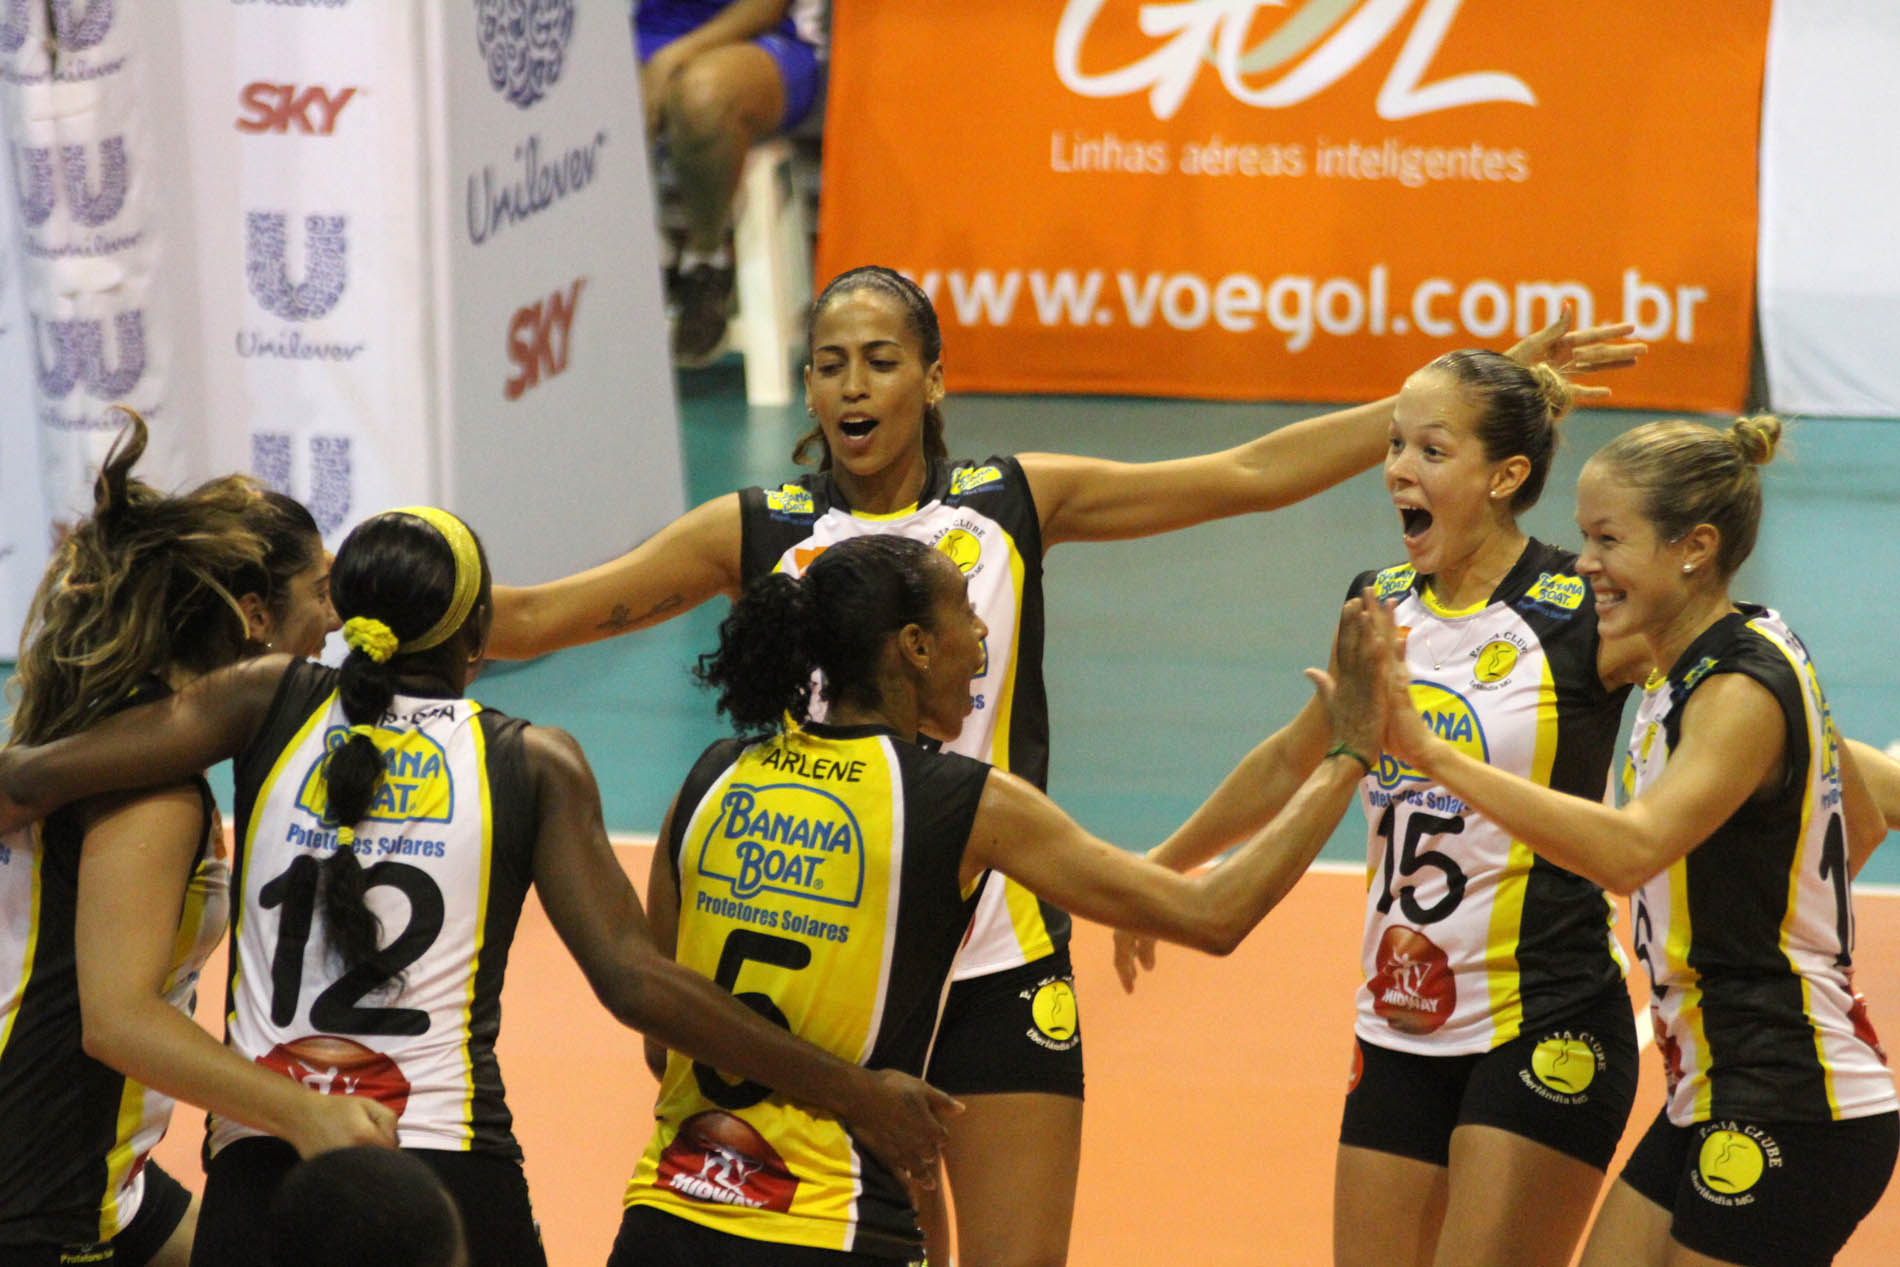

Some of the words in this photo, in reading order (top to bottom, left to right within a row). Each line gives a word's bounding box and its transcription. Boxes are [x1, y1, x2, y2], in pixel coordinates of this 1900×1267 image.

[1053, 0, 1538, 121] GOL
[234, 82, 358, 135] SKY
[467, 131, 606, 246] Unilever
[1049, 130, 1168, 173] Linhas
[1180, 134, 1306, 176] aéreas
[1315, 136, 1532, 187] inteligentes
[504, 275, 590, 401] SKY
[918, 265, 1708, 352] ww.voegol.com.br
[235, 330, 364, 361] Unilever
[761, 748, 867, 783] ARLENE
[721, 790, 851, 854] BANANA
[736, 841, 825, 891] BOAT
[1376, 803, 1468, 925] 15
[258, 854, 445, 1036] 12
[697, 891, 778, 928] Protetores
[781, 910, 849, 943] Solares
